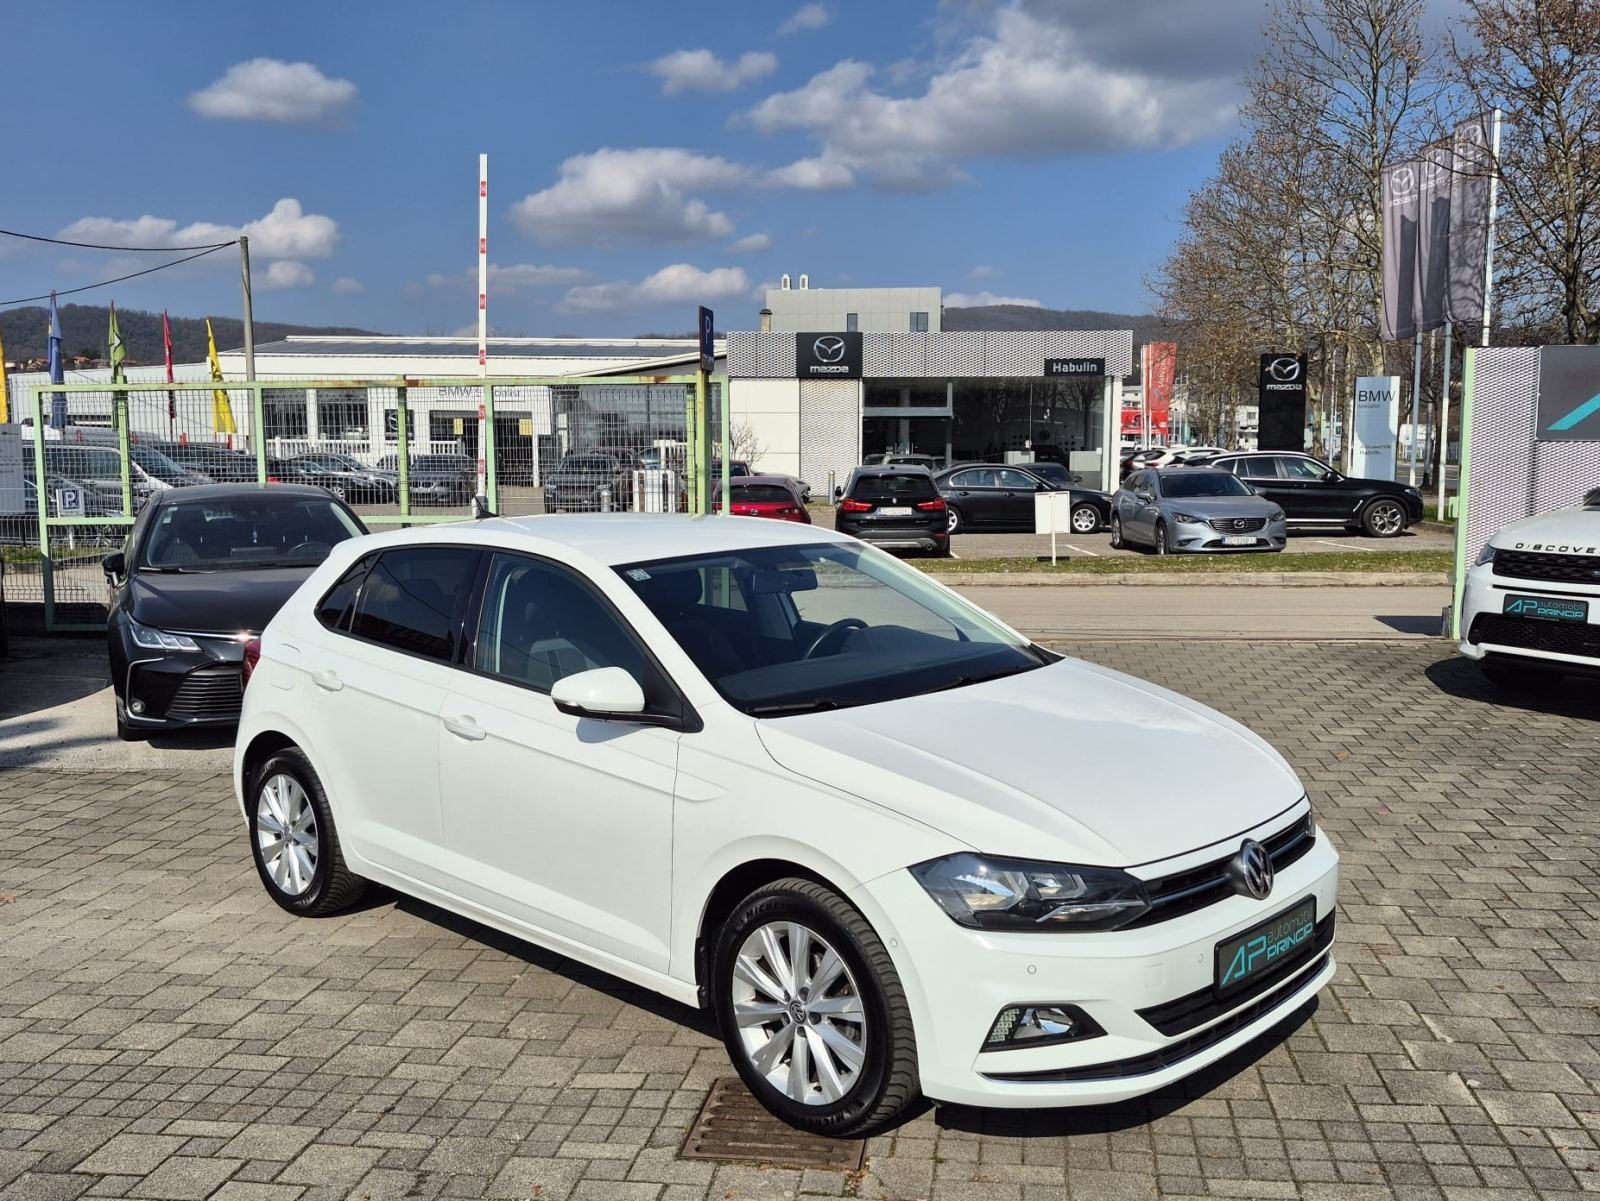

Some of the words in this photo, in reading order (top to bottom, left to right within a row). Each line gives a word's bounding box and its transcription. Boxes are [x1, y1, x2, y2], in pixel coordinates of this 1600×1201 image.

[704, 314, 711, 345] P
[809, 365, 849, 373] mazda
[1052, 361, 1097, 373] Habulin
[1266, 383, 1302, 391] mazda
[1358, 390, 1396, 402] BMW
[65, 491, 76, 508] P
[1505, 599, 1538, 614] AP
[1537, 607, 1585, 618] PRINCIP
[1267, 906, 1313, 943] automobil
[1266, 923, 1313, 960] PRINCIP
[1221, 935, 1267, 985] AP
